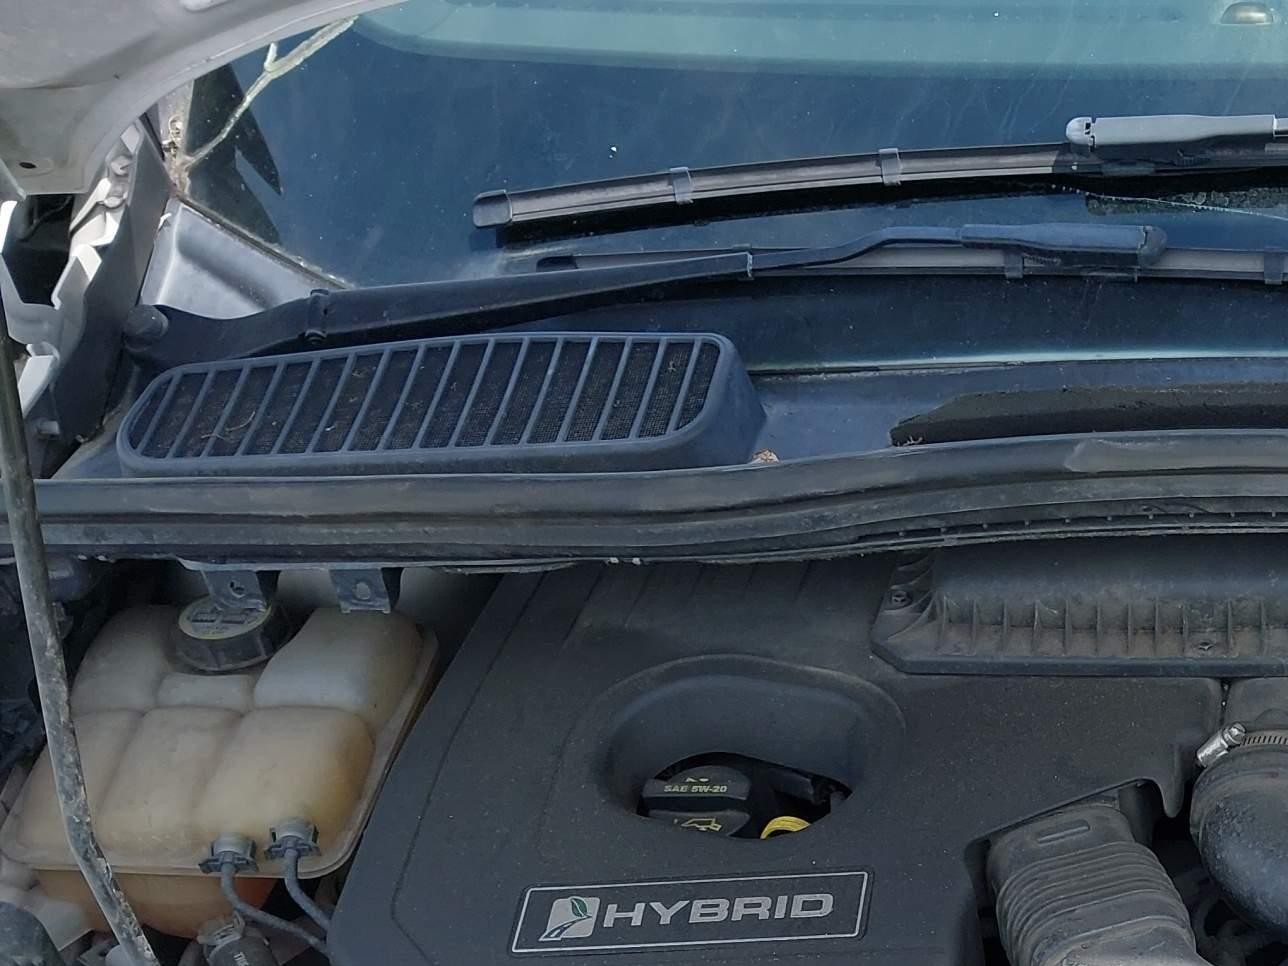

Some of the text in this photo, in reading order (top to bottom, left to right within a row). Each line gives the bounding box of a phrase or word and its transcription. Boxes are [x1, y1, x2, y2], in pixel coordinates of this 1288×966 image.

[663, 784, 728, 793] SAE 5W-20
[603, 893, 834, 928] HYBRID
